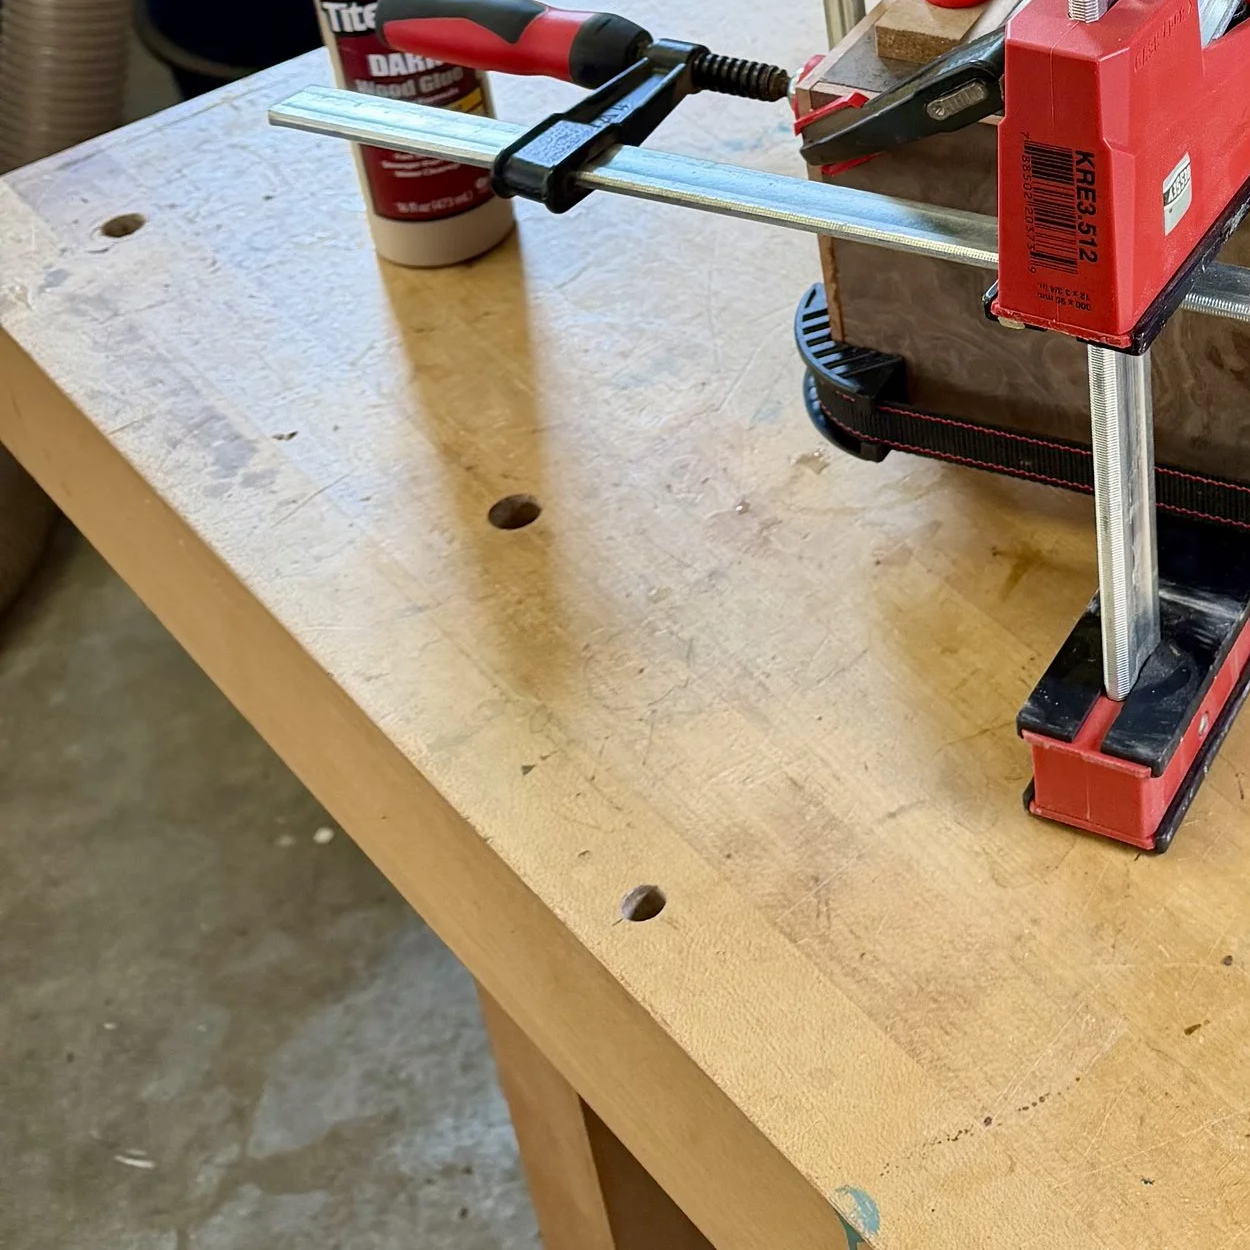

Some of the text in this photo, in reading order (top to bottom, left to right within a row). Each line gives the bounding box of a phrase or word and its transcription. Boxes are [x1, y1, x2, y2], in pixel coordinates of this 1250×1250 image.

[1021, 154, 1033, 200] 88502
[1024, 207, 1036, 251] 20373
[1075, 150, 1098, 263] KRE3.512
[1028, 265, 1037, 274] 9
